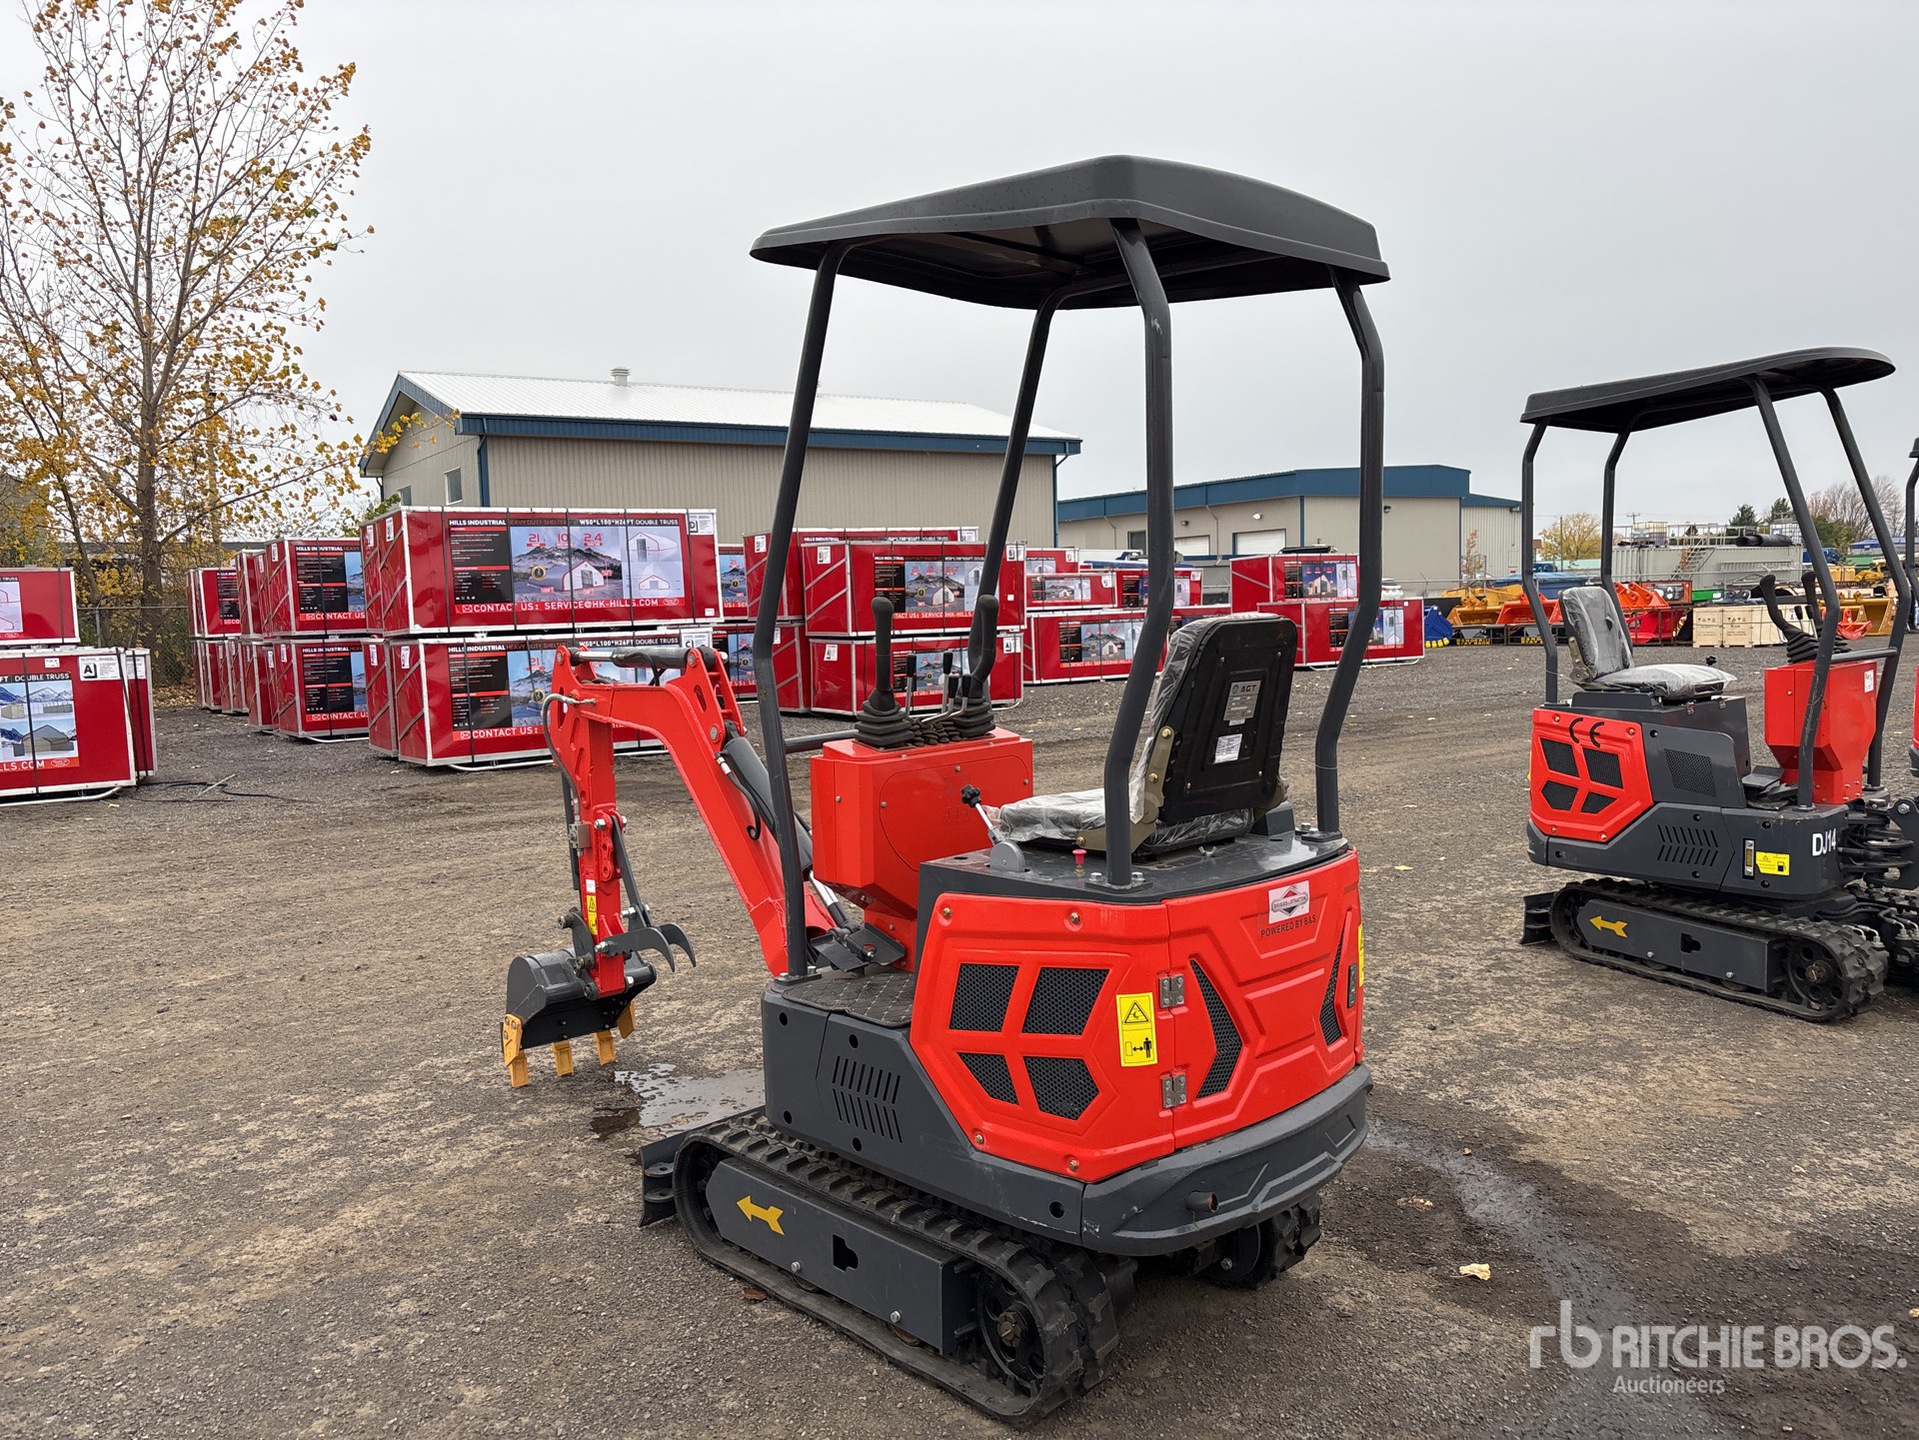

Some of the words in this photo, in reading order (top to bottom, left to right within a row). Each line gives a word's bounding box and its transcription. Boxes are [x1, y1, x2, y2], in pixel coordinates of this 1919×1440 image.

[466, 644, 506, 652] INDUSTRIAL
[83, 664, 93, 675] A
[46, 670, 70, 681] TRUSS
[472, 727, 517, 739] CONTACT
[1811, 828, 1837, 857] DJ14
[1260, 921, 1294, 938] POWERED
[1294, 919, 1304, 929] BY
